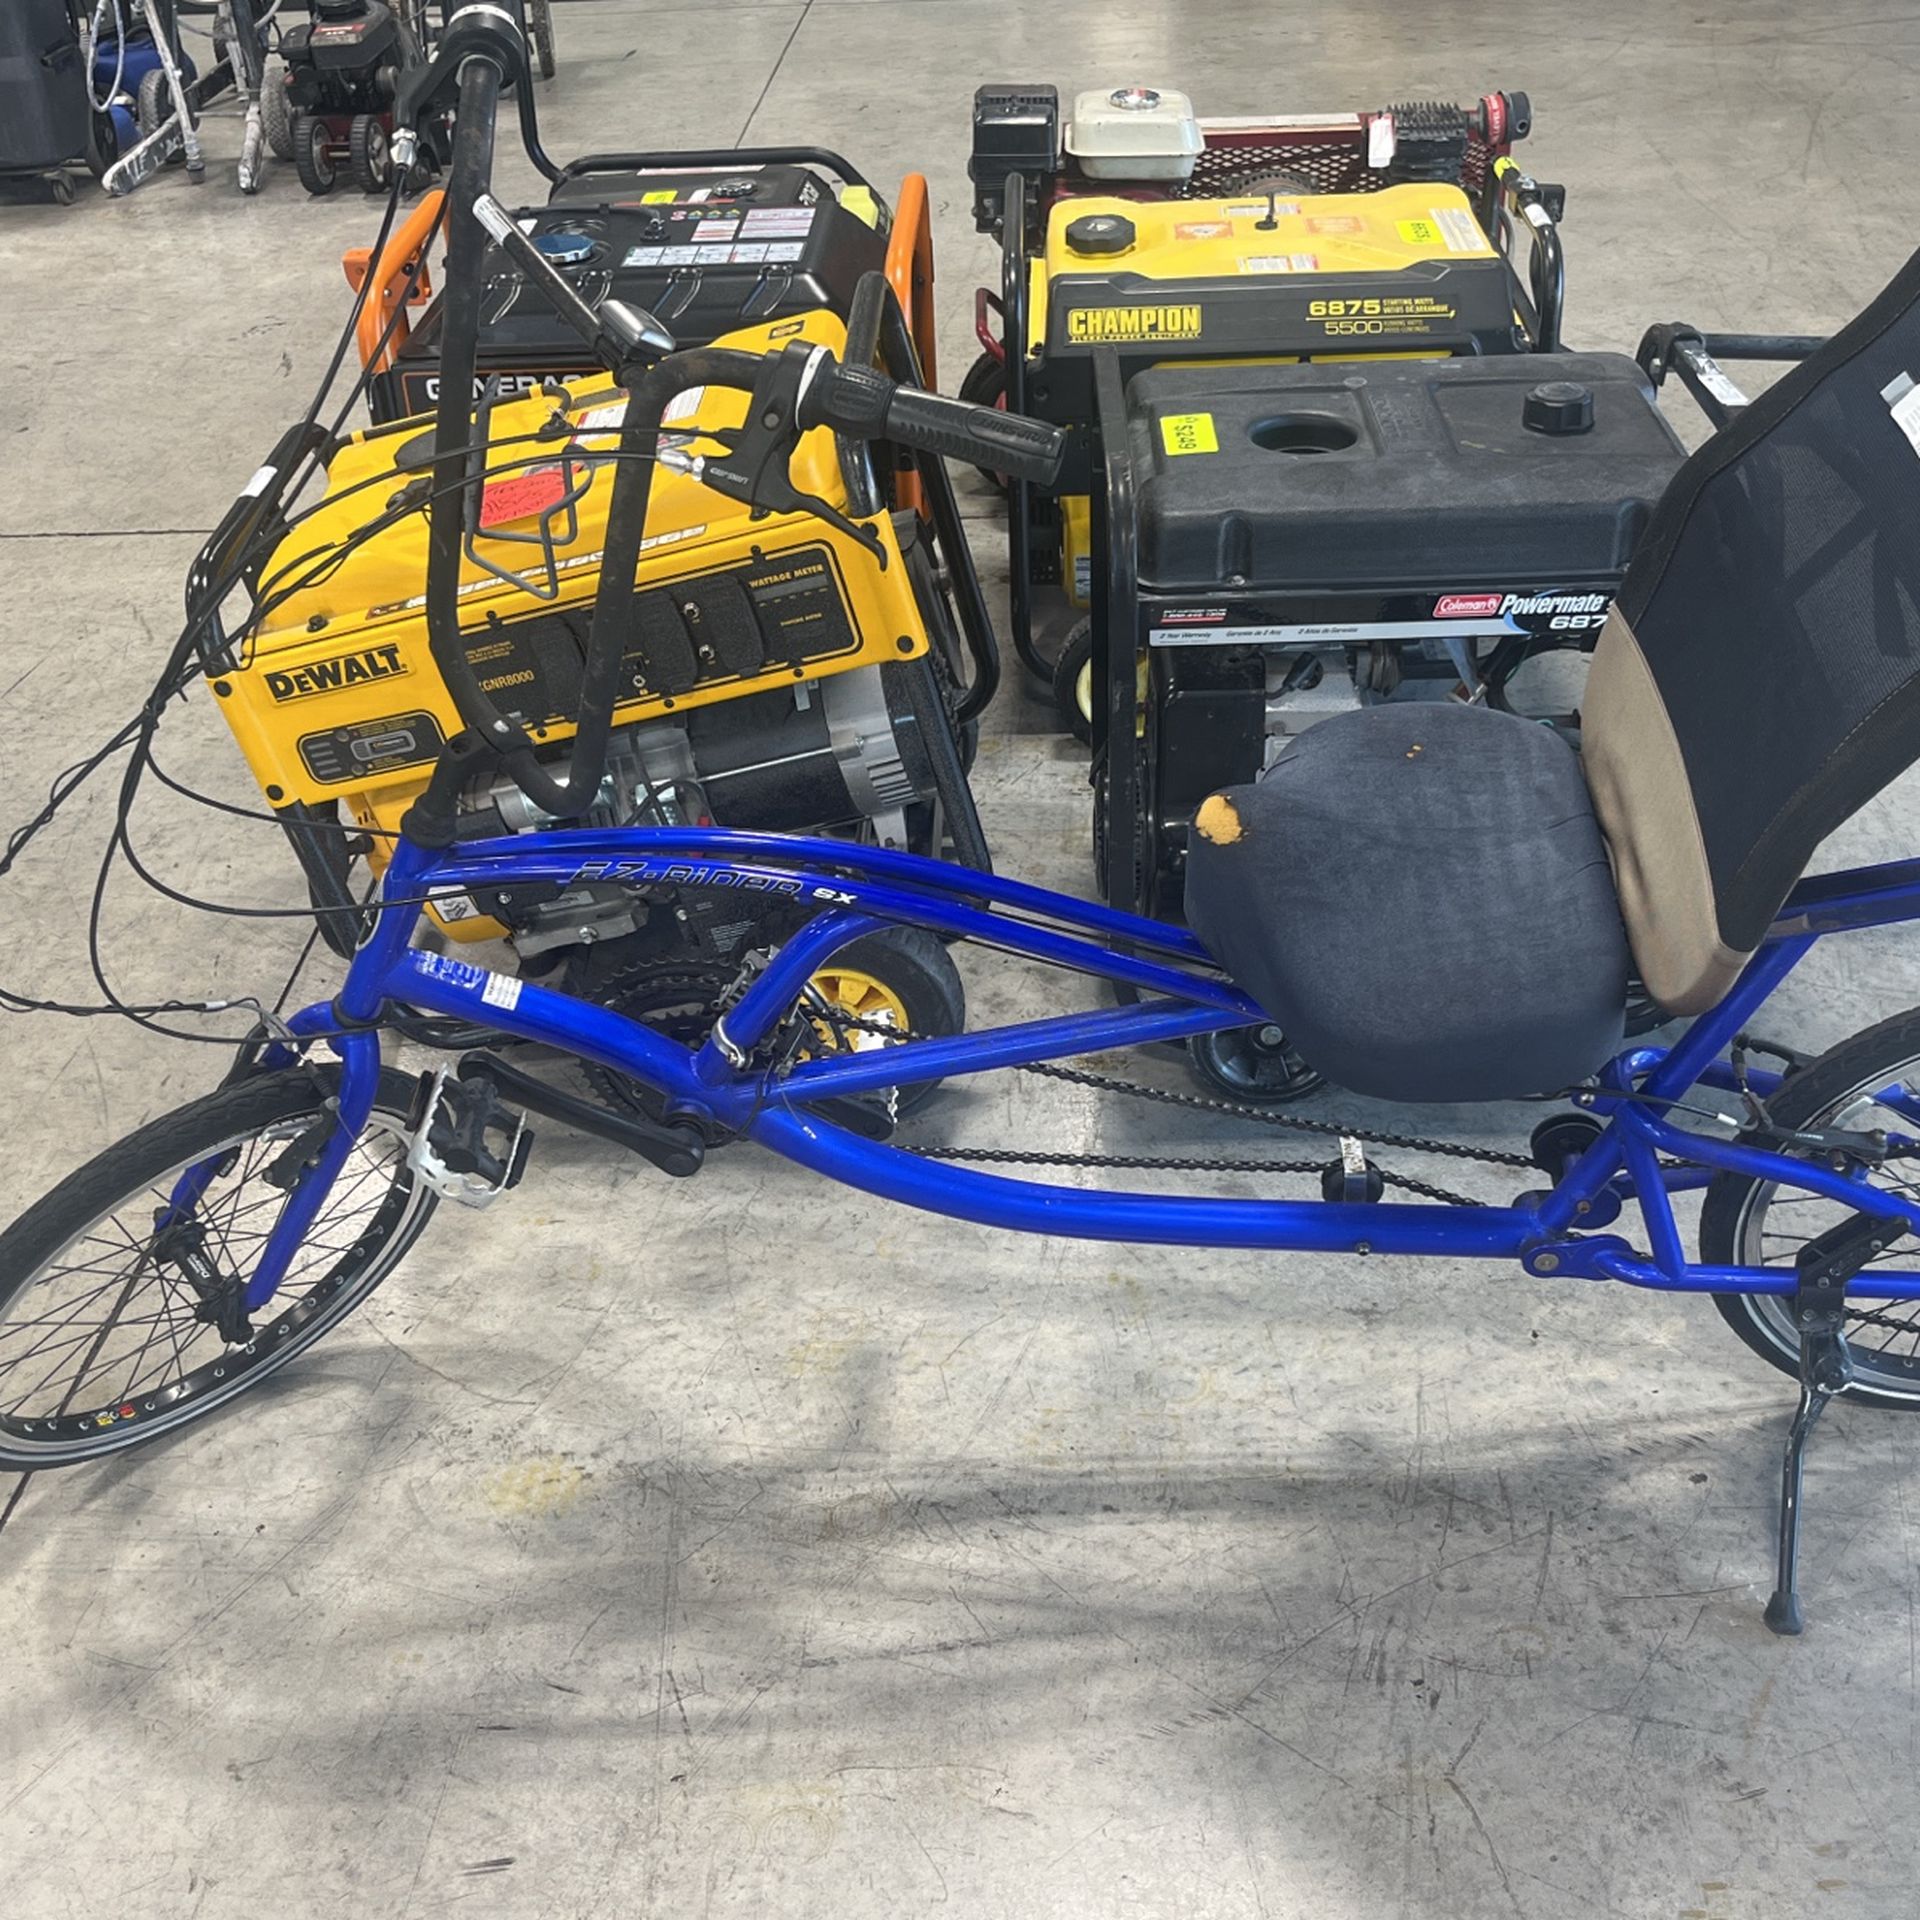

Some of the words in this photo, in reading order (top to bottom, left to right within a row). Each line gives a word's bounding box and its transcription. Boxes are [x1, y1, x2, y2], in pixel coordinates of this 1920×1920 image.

[1309, 299, 1381, 316] 6875
[1071, 307, 1199, 335] CHAMPION
[1325, 320, 1383, 335] 5500
[426, 374, 584, 401] GNERA
[748, 571, 792, 588] WATTAGE
[793, 563, 824, 577] METER
[1440, 597, 1486, 613] Coleman
[1498, 594, 1605, 615] Powermate
